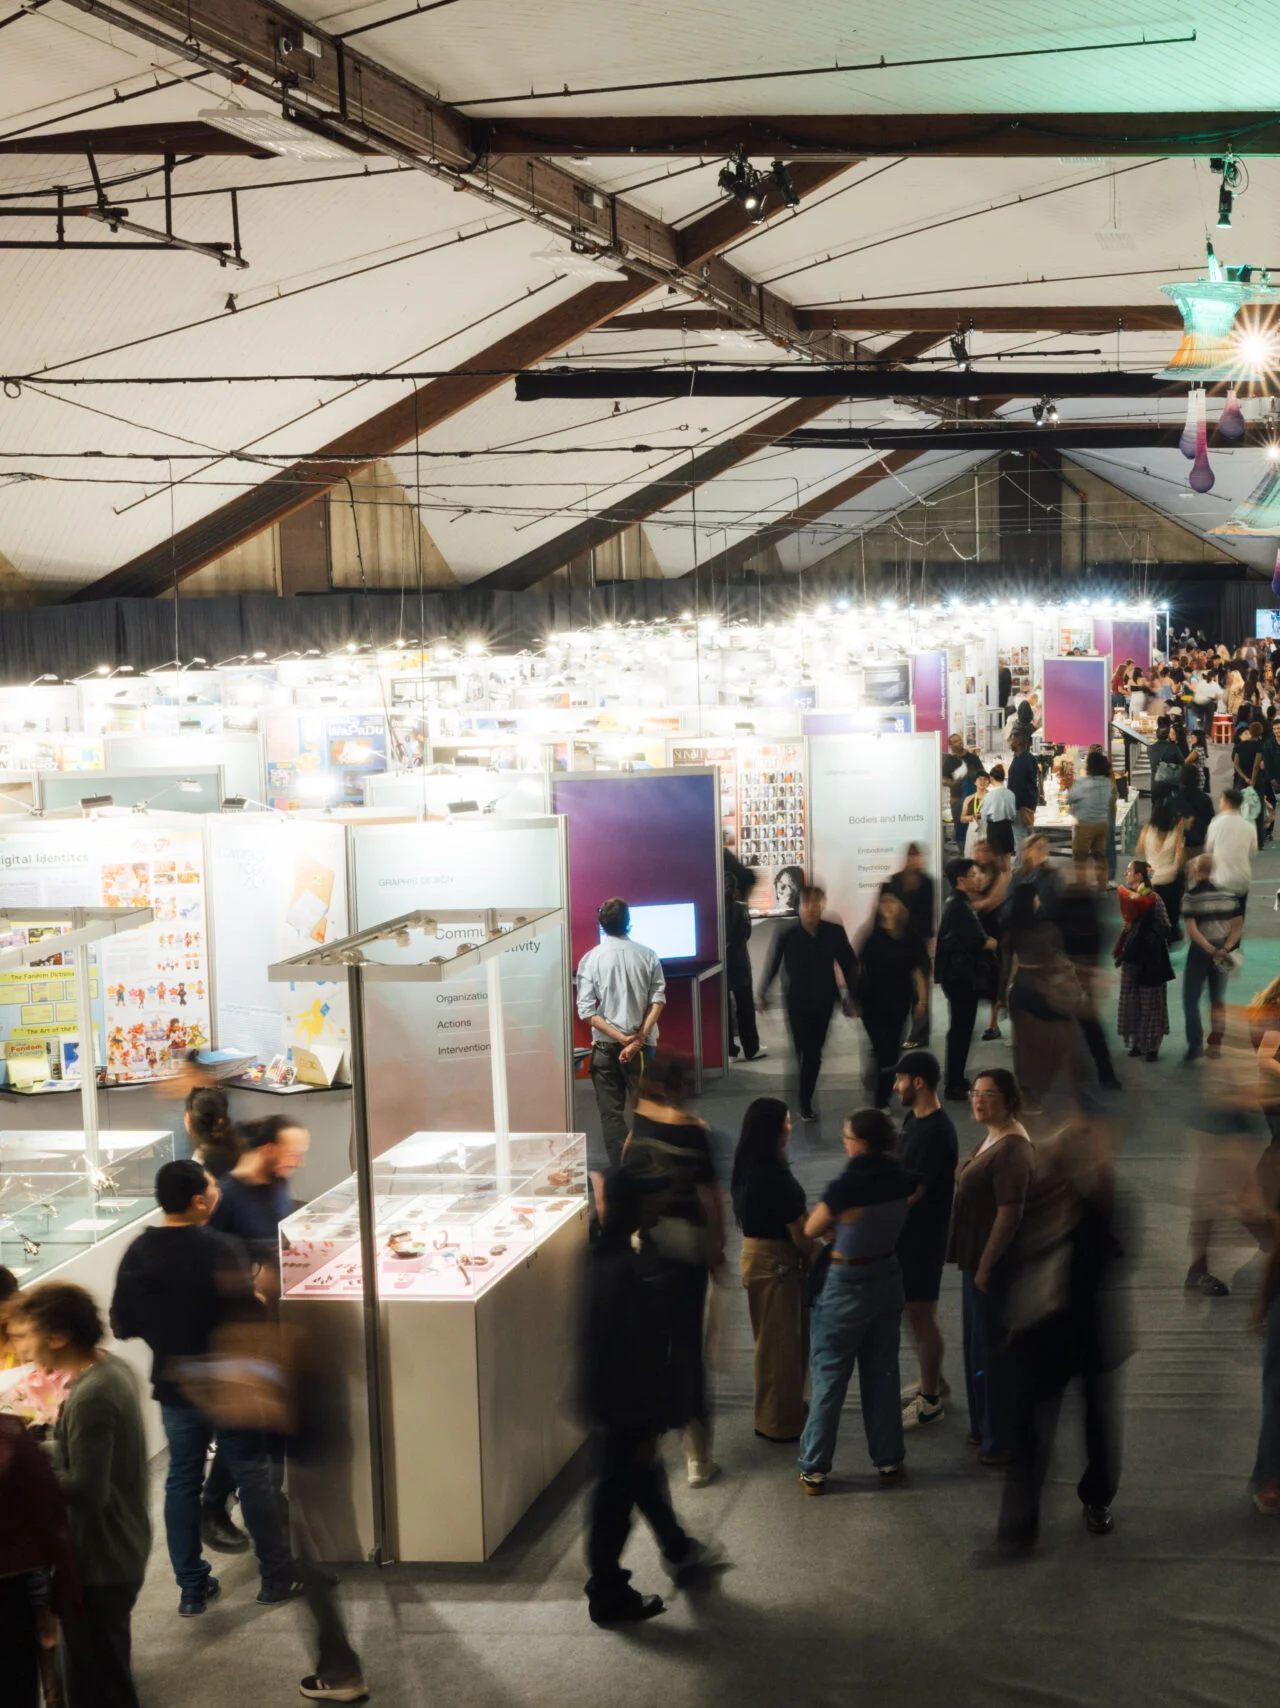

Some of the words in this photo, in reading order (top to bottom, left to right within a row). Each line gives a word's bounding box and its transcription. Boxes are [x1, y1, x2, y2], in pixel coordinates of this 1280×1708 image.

[848, 815, 878, 825] Bodies
[880, 814, 896, 823] and
[898, 813, 924, 822] Minds
[0, 853, 32, 867] igital
[857, 864, 891, 873] Psychology
[435, 926, 512, 940] Commuty
[436, 991, 489, 1004] Organizatio
[437, 1018, 472, 1029] Actions
[10, 1044, 43, 1053] Fandom
